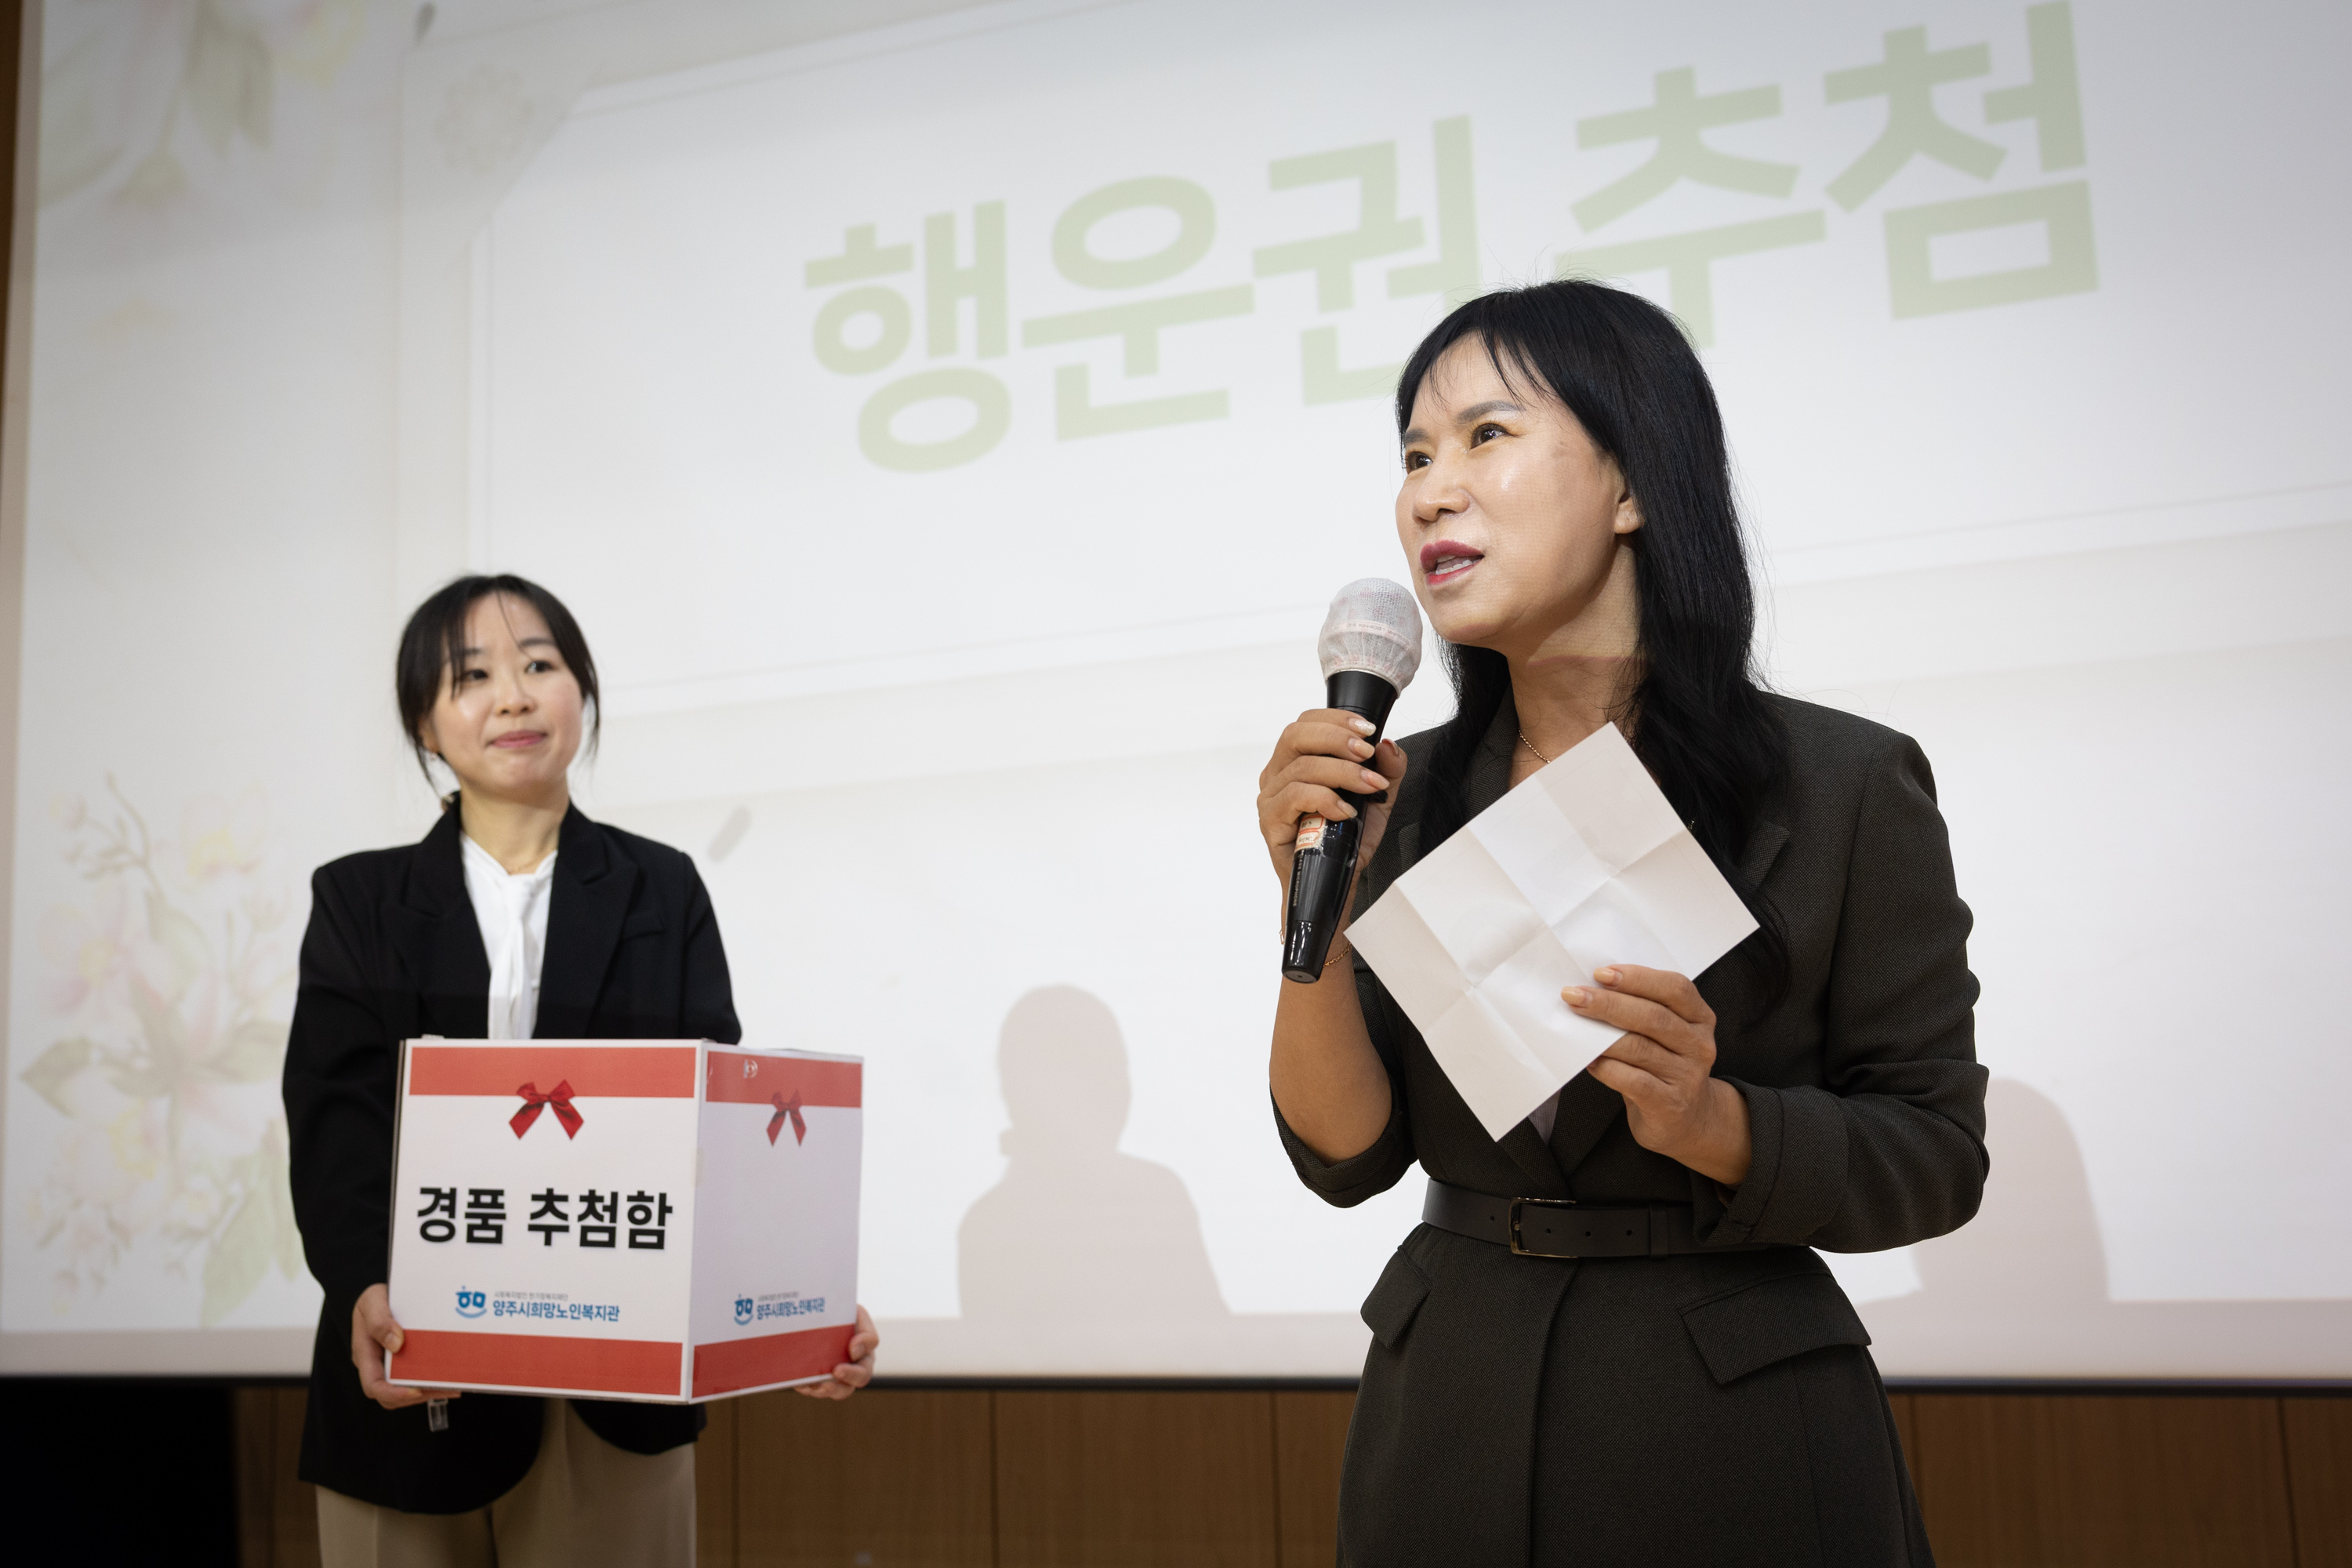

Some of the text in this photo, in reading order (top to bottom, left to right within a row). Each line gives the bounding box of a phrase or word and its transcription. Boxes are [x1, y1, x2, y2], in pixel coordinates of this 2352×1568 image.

[804, 0, 2099, 474] 행운권 추첨
[417, 1186, 673, 1250] 경품 추첨함
[492, 1300, 620, 1322] 양주시희망노인복지관
